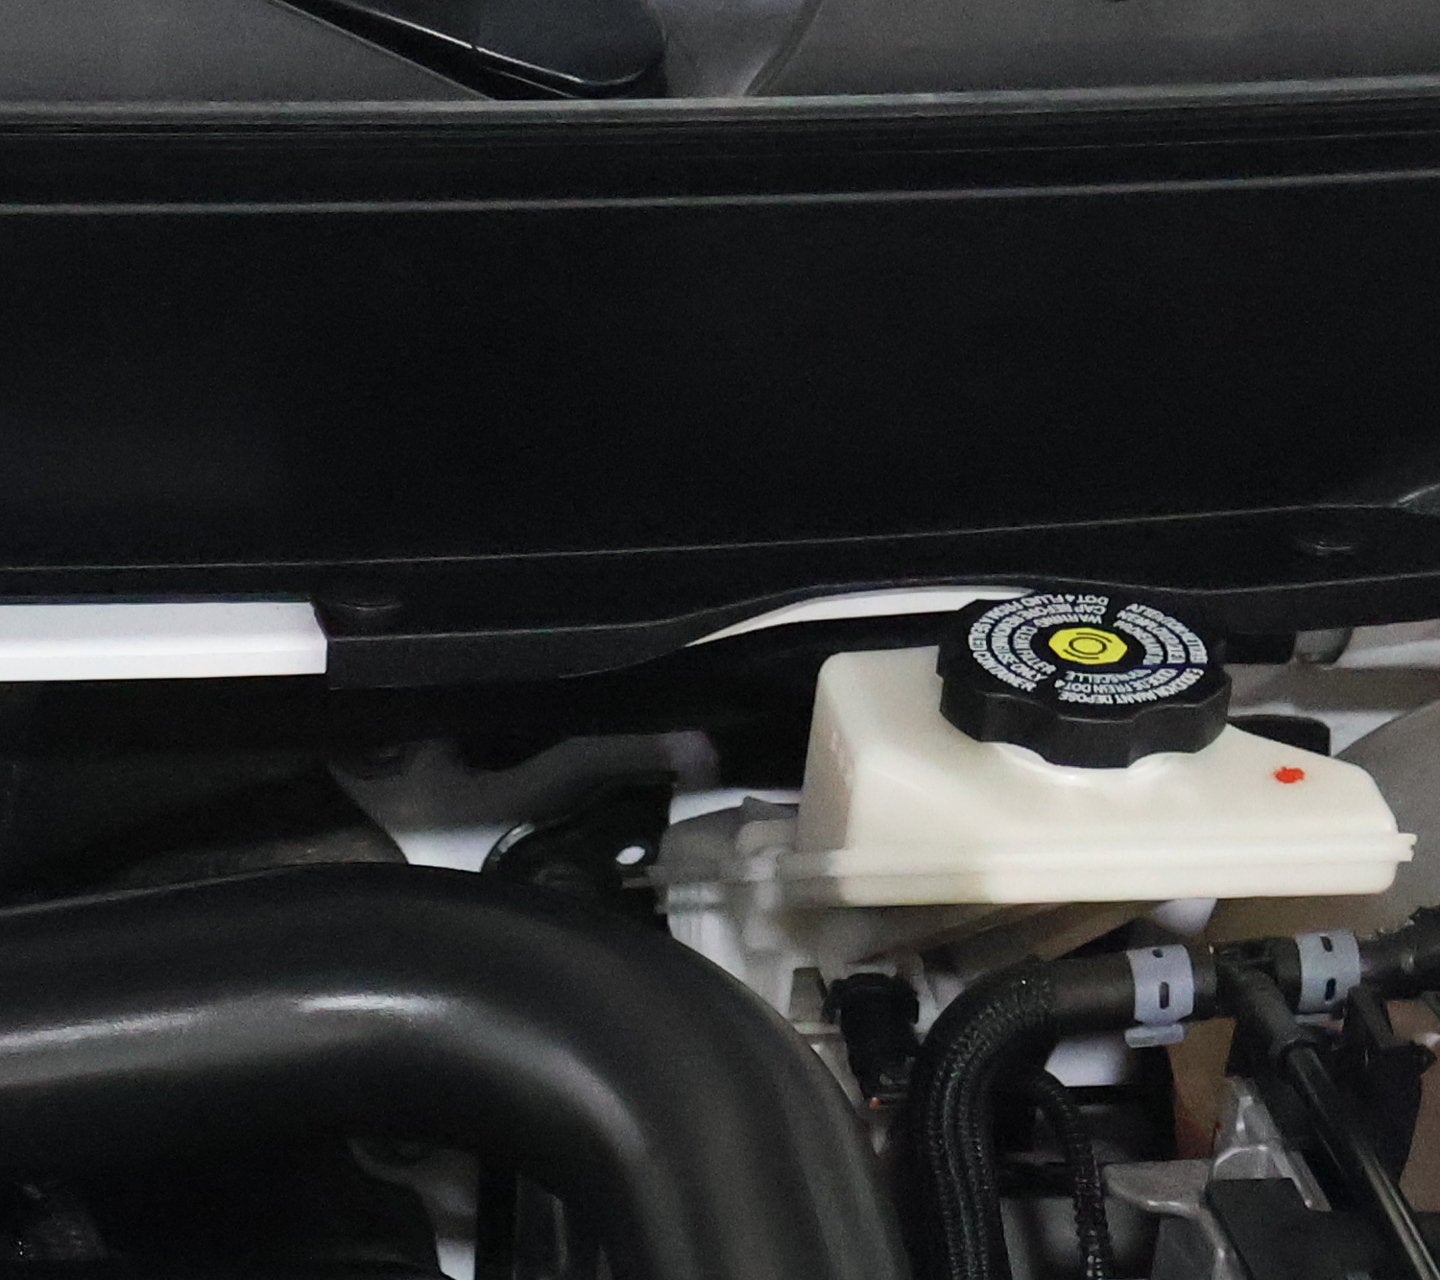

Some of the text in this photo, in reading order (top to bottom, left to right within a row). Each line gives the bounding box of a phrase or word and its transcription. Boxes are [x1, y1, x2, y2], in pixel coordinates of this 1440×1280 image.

[1077, 596, 1111, 606] DOT
[1075, 606, 1107, 615] CAP
[1066, 683, 1092, 693] DOT
